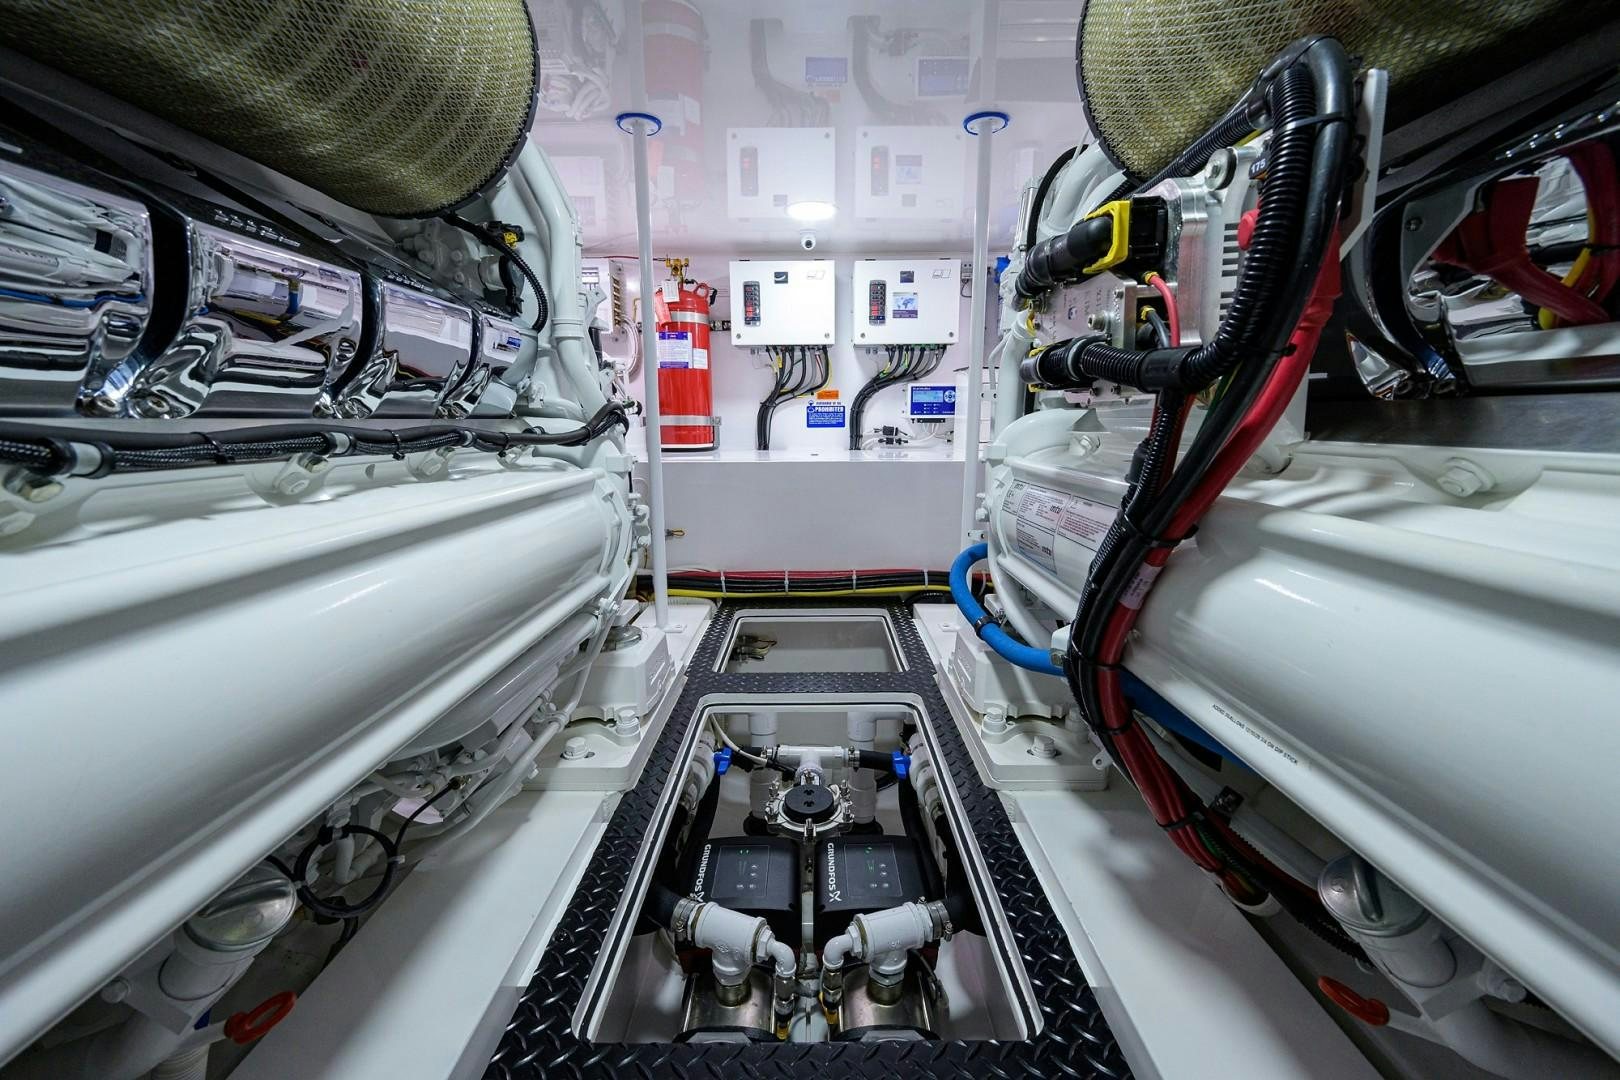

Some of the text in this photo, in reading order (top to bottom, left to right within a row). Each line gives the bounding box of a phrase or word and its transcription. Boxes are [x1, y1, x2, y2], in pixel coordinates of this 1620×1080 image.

[1251, 158, 1266, 174] 175
[695, 844, 712, 892] GRUNDFOS
[827, 843, 836, 891] GRUNDFOS
